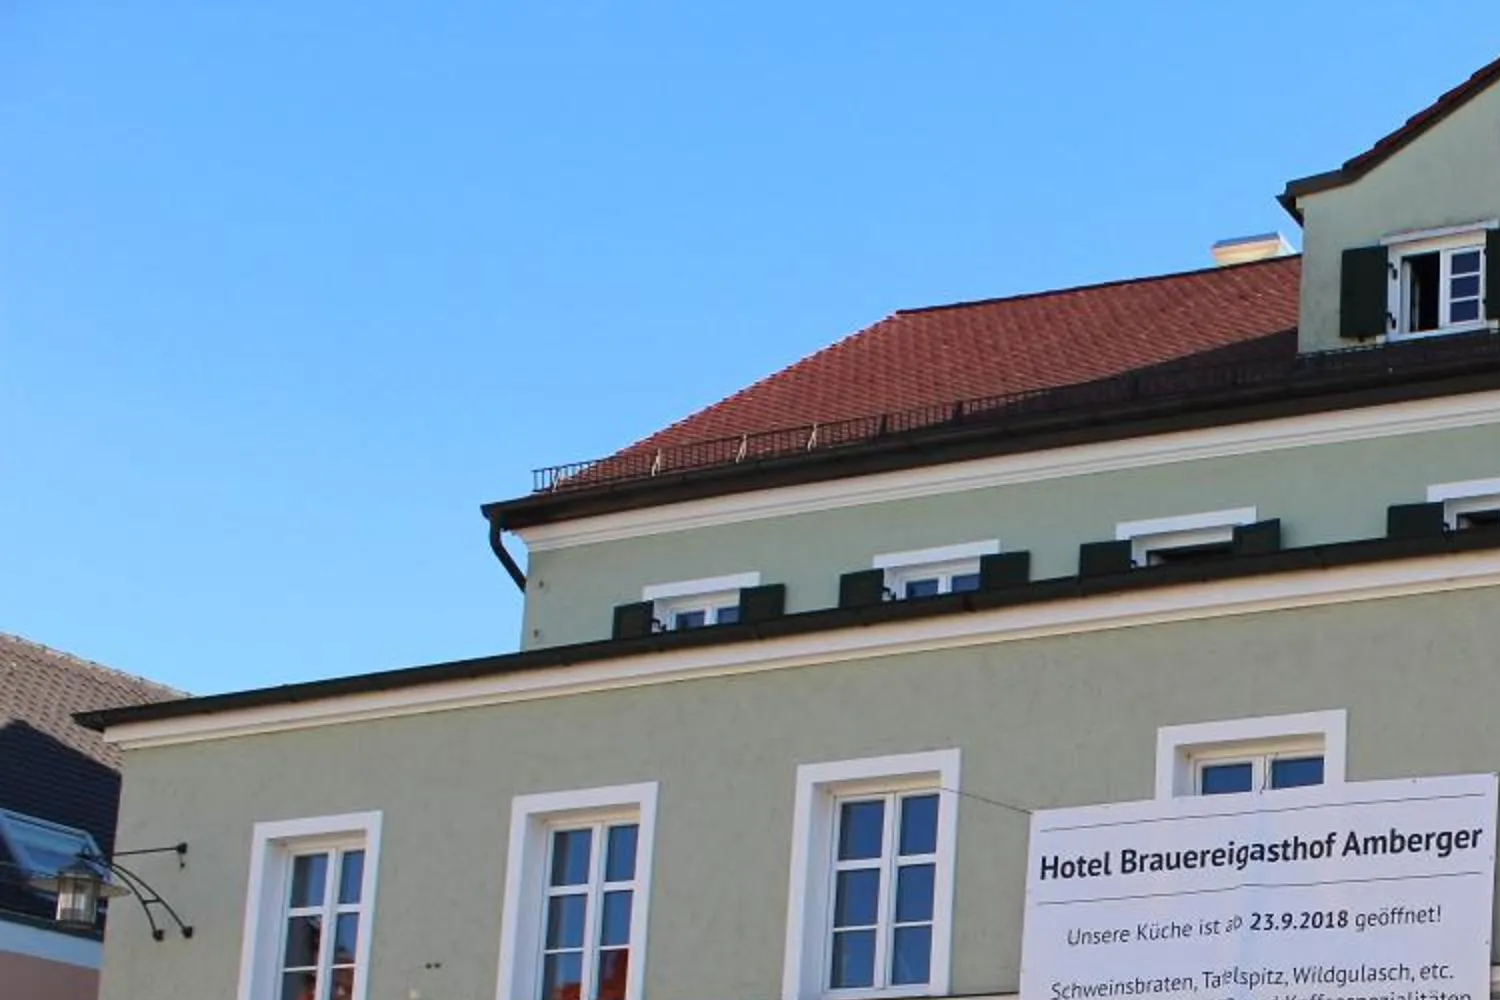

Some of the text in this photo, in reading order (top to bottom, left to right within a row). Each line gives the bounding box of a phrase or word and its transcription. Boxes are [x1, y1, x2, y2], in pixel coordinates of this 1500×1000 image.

[1039, 827, 1483, 881] Hotel Brauereigasthof Amberger
[1067, 927, 1131, 947] Unsere
[1136, 919, 1193, 941] Küche
[1199, 919, 1221, 936] ist
[1249, 909, 1349, 931] 23.9.2018
[1355, 904, 1442, 933] geöffnet!
[1201, 965, 1289, 991] Taelspitz,
[1292, 962, 1415, 989] Wildgulasch,
[1419, 963, 1456, 981] etc.
